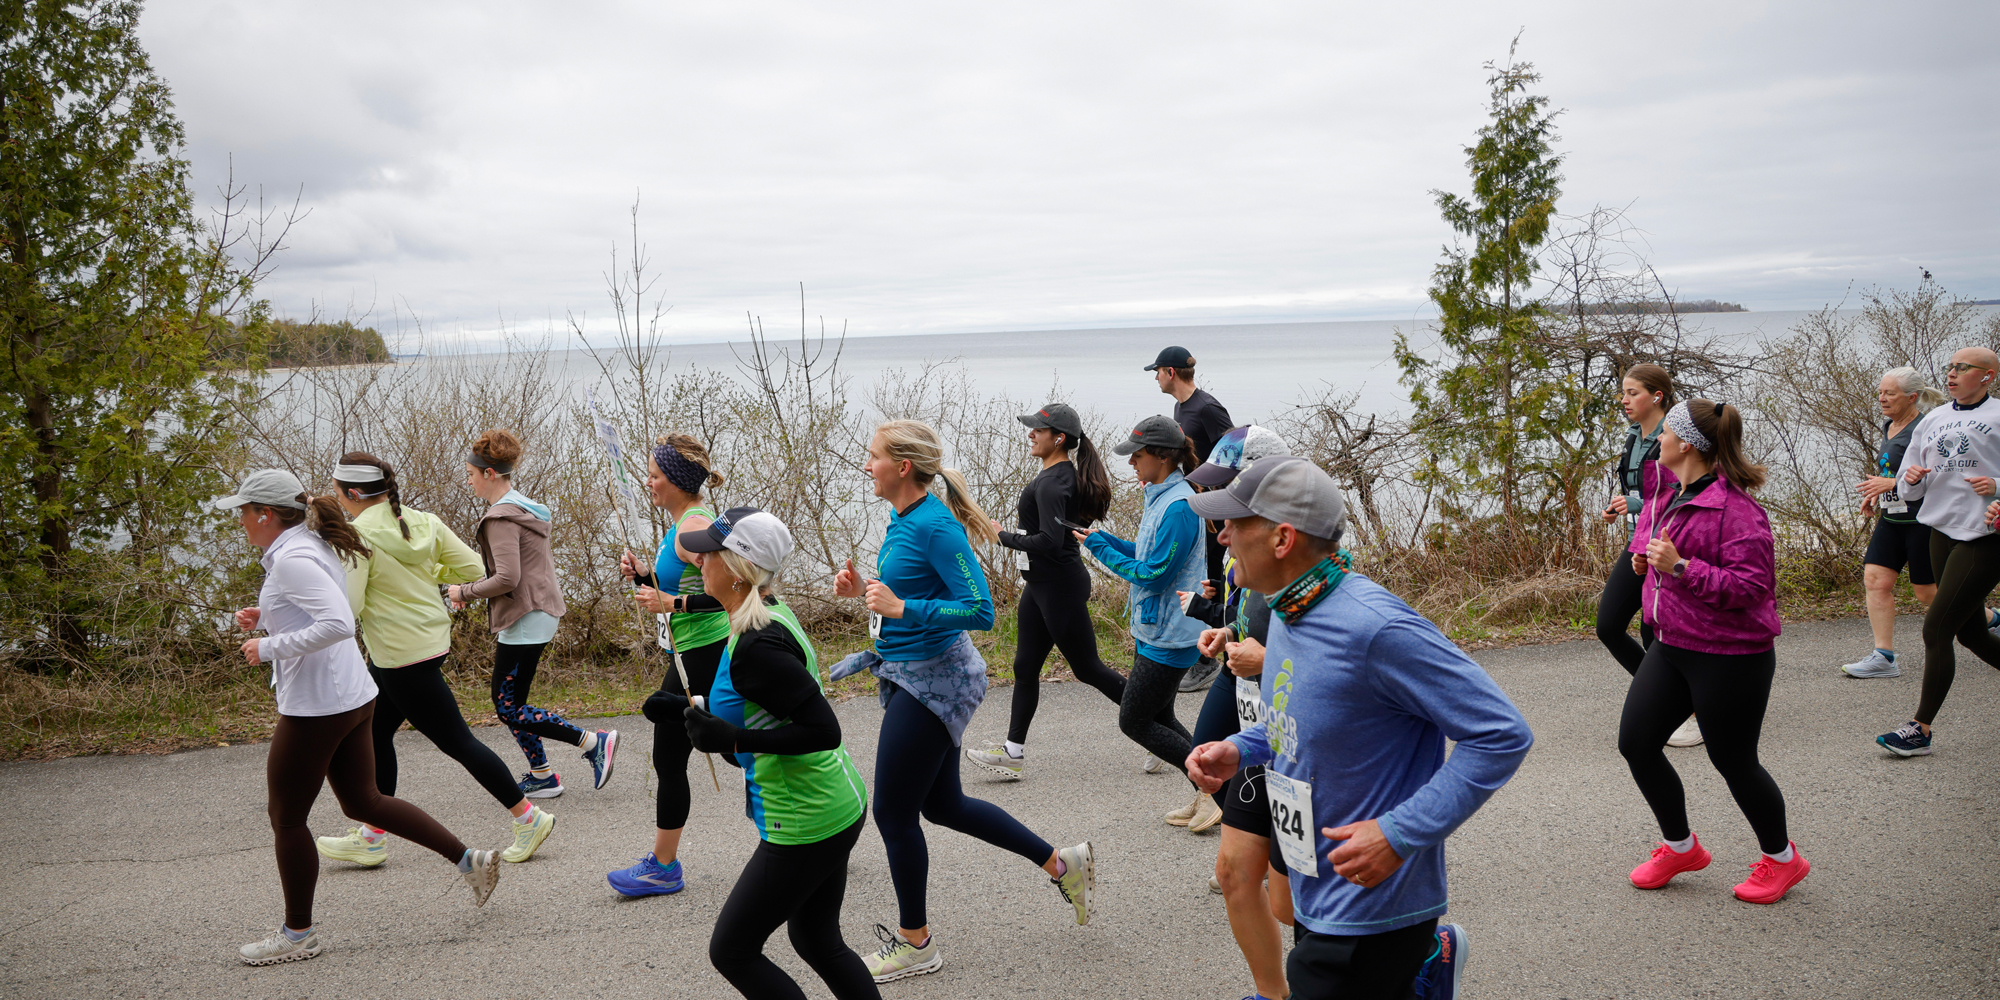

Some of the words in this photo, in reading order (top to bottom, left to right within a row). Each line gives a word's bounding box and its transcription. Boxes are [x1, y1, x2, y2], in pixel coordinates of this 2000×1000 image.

[1927, 421, 1962, 444] ALPHA
[1967, 420, 1992, 435] PHI
[955, 552, 972, 578] DOOR
[1260, 699, 1299, 741] DOOR
[1271, 798, 1305, 842] 424
[1439, 930, 1451, 963] HOKA
